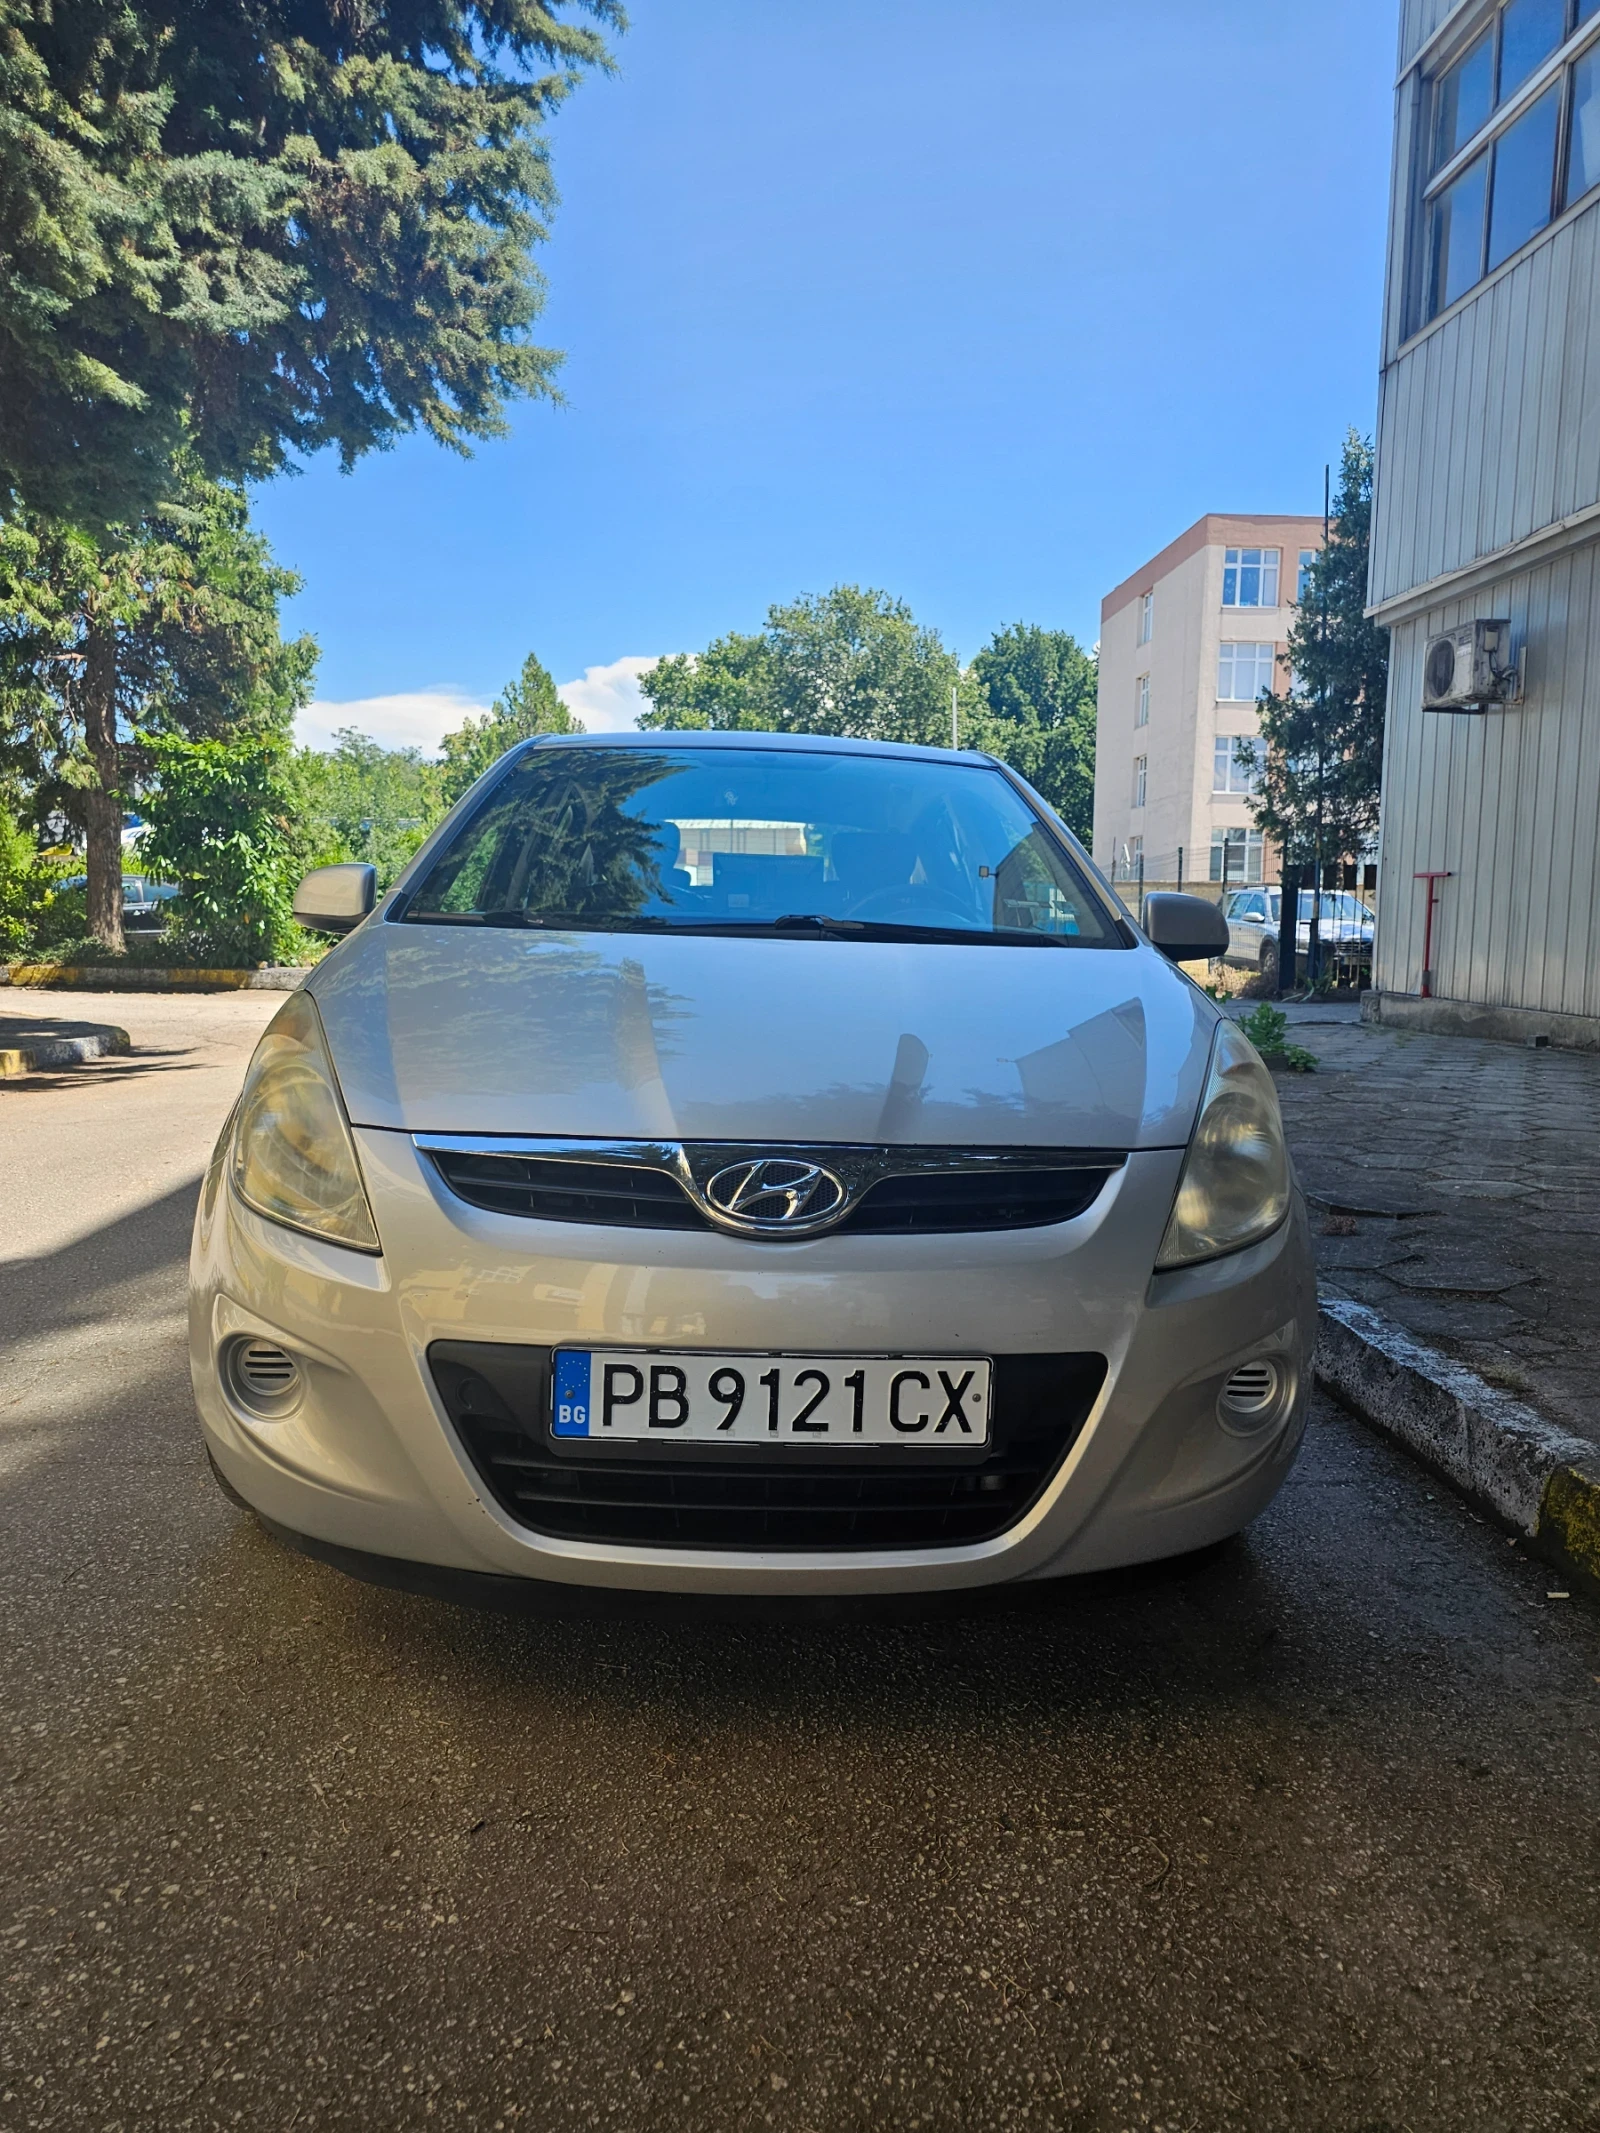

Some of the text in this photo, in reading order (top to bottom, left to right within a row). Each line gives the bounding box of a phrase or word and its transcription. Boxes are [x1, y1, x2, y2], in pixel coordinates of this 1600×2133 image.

[558, 1404, 587, 1424] BG
[602, 1363, 976, 1433] PB 9121 CX
